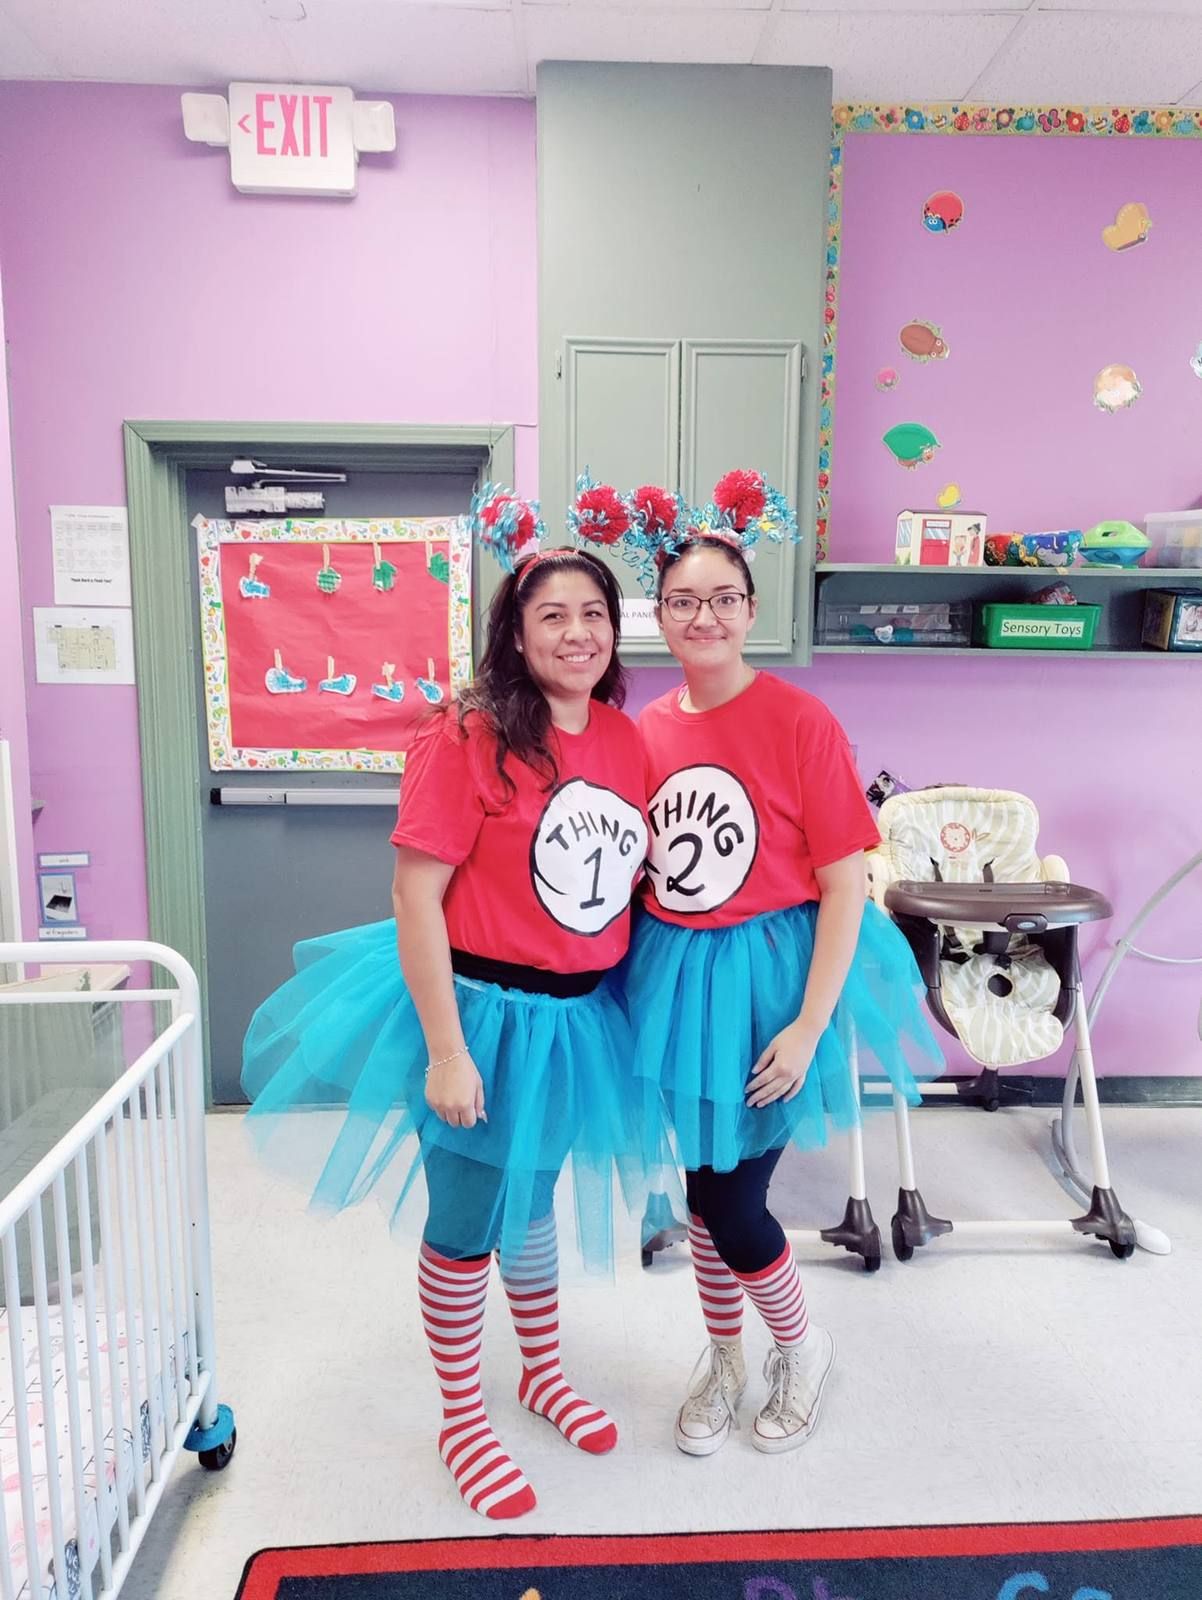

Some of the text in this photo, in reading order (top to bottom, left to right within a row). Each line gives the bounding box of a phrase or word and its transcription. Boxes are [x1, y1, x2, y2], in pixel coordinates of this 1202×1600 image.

[255, 93, 333, 158] EXIT
[1002, 621, 1082, 637] Sensory Toys
[545, 811, 638, 857] THING
[648, 790, 744, 857] THING
[579, 847, 606, 910] 1
[666, 832, 705, 897] 2
